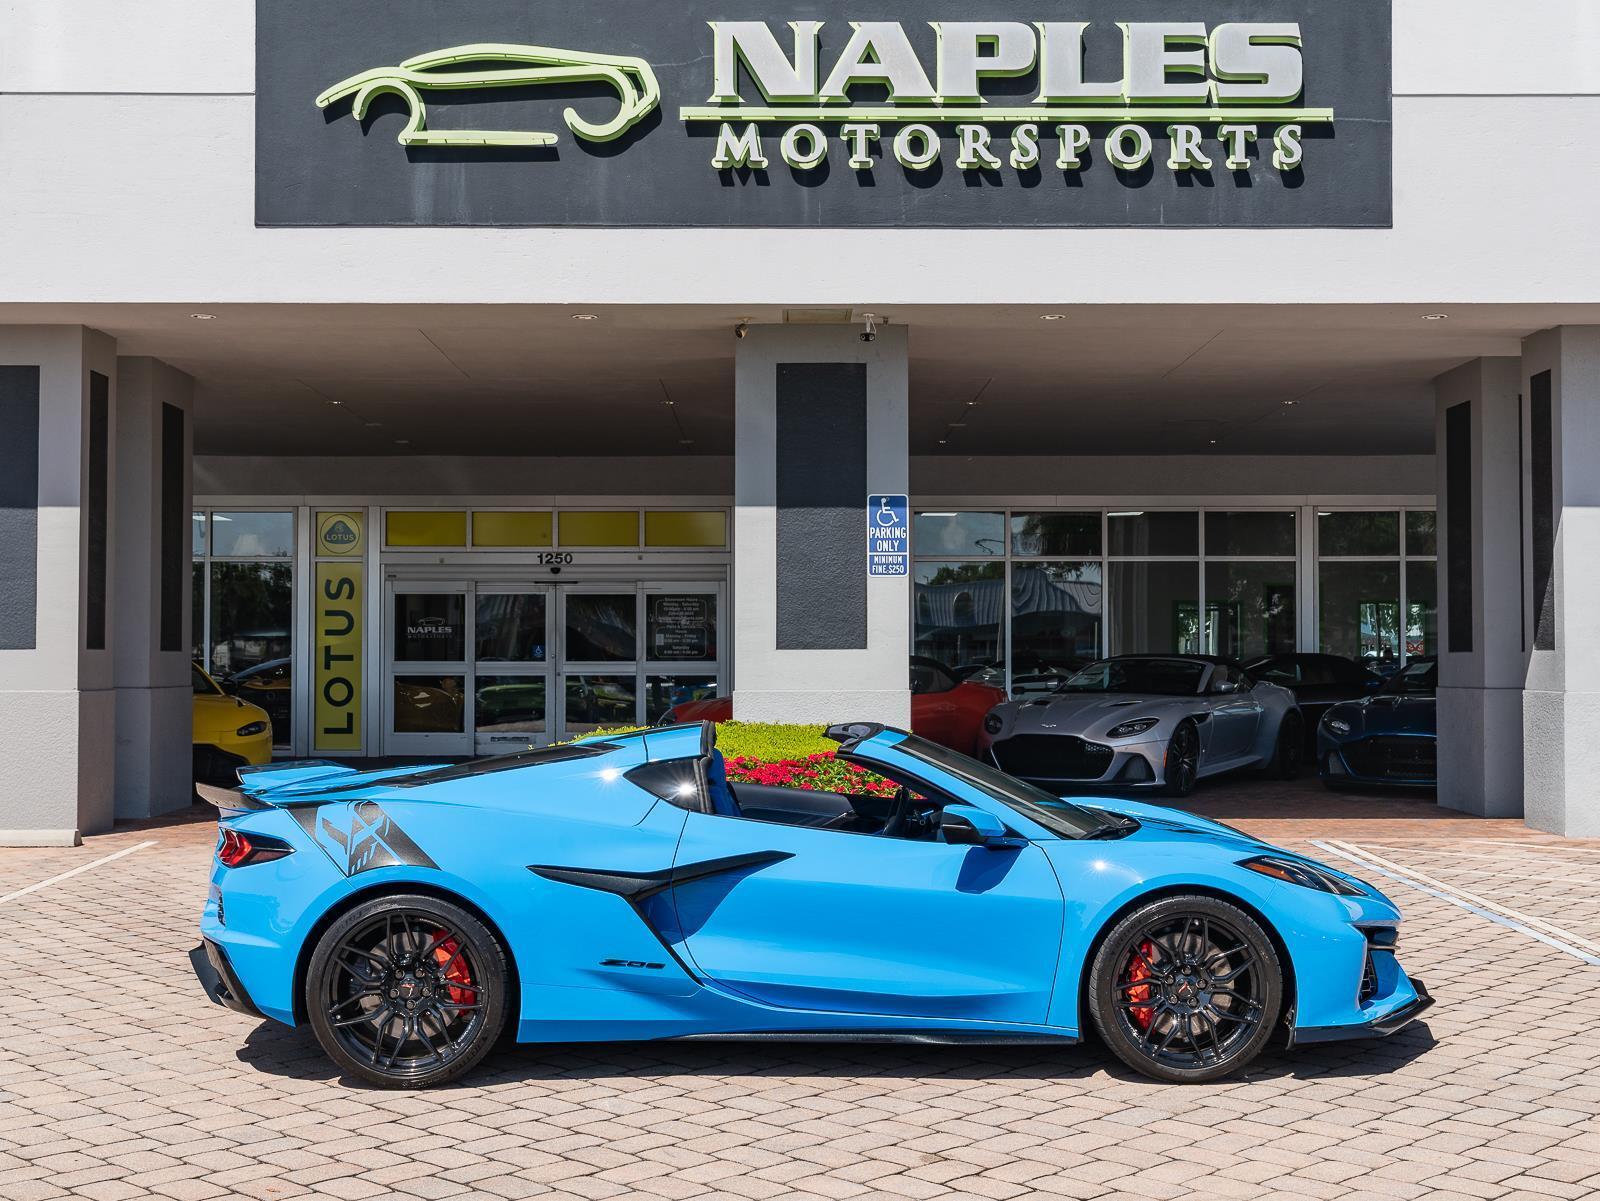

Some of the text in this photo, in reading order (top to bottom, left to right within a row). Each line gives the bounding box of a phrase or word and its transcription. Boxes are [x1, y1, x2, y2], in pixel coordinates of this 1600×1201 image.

[706, 21, 1303, 104] NAPLES
[710, 121, 1304, 172] MOTORSPORTS
[326, 533, 355, 541] LOTUS
[870, 527, 906, 538] PARKING
[876, 540, 899, 551] ONLY
[537, 552, 573, 564] 1250
[874, 556, 902, 564] MINIMUM
[872, 565, 904, 574] FINE $250
[407, 626, 452, 634] NAPLES
[323, 577, 354, 734] LOTUS
